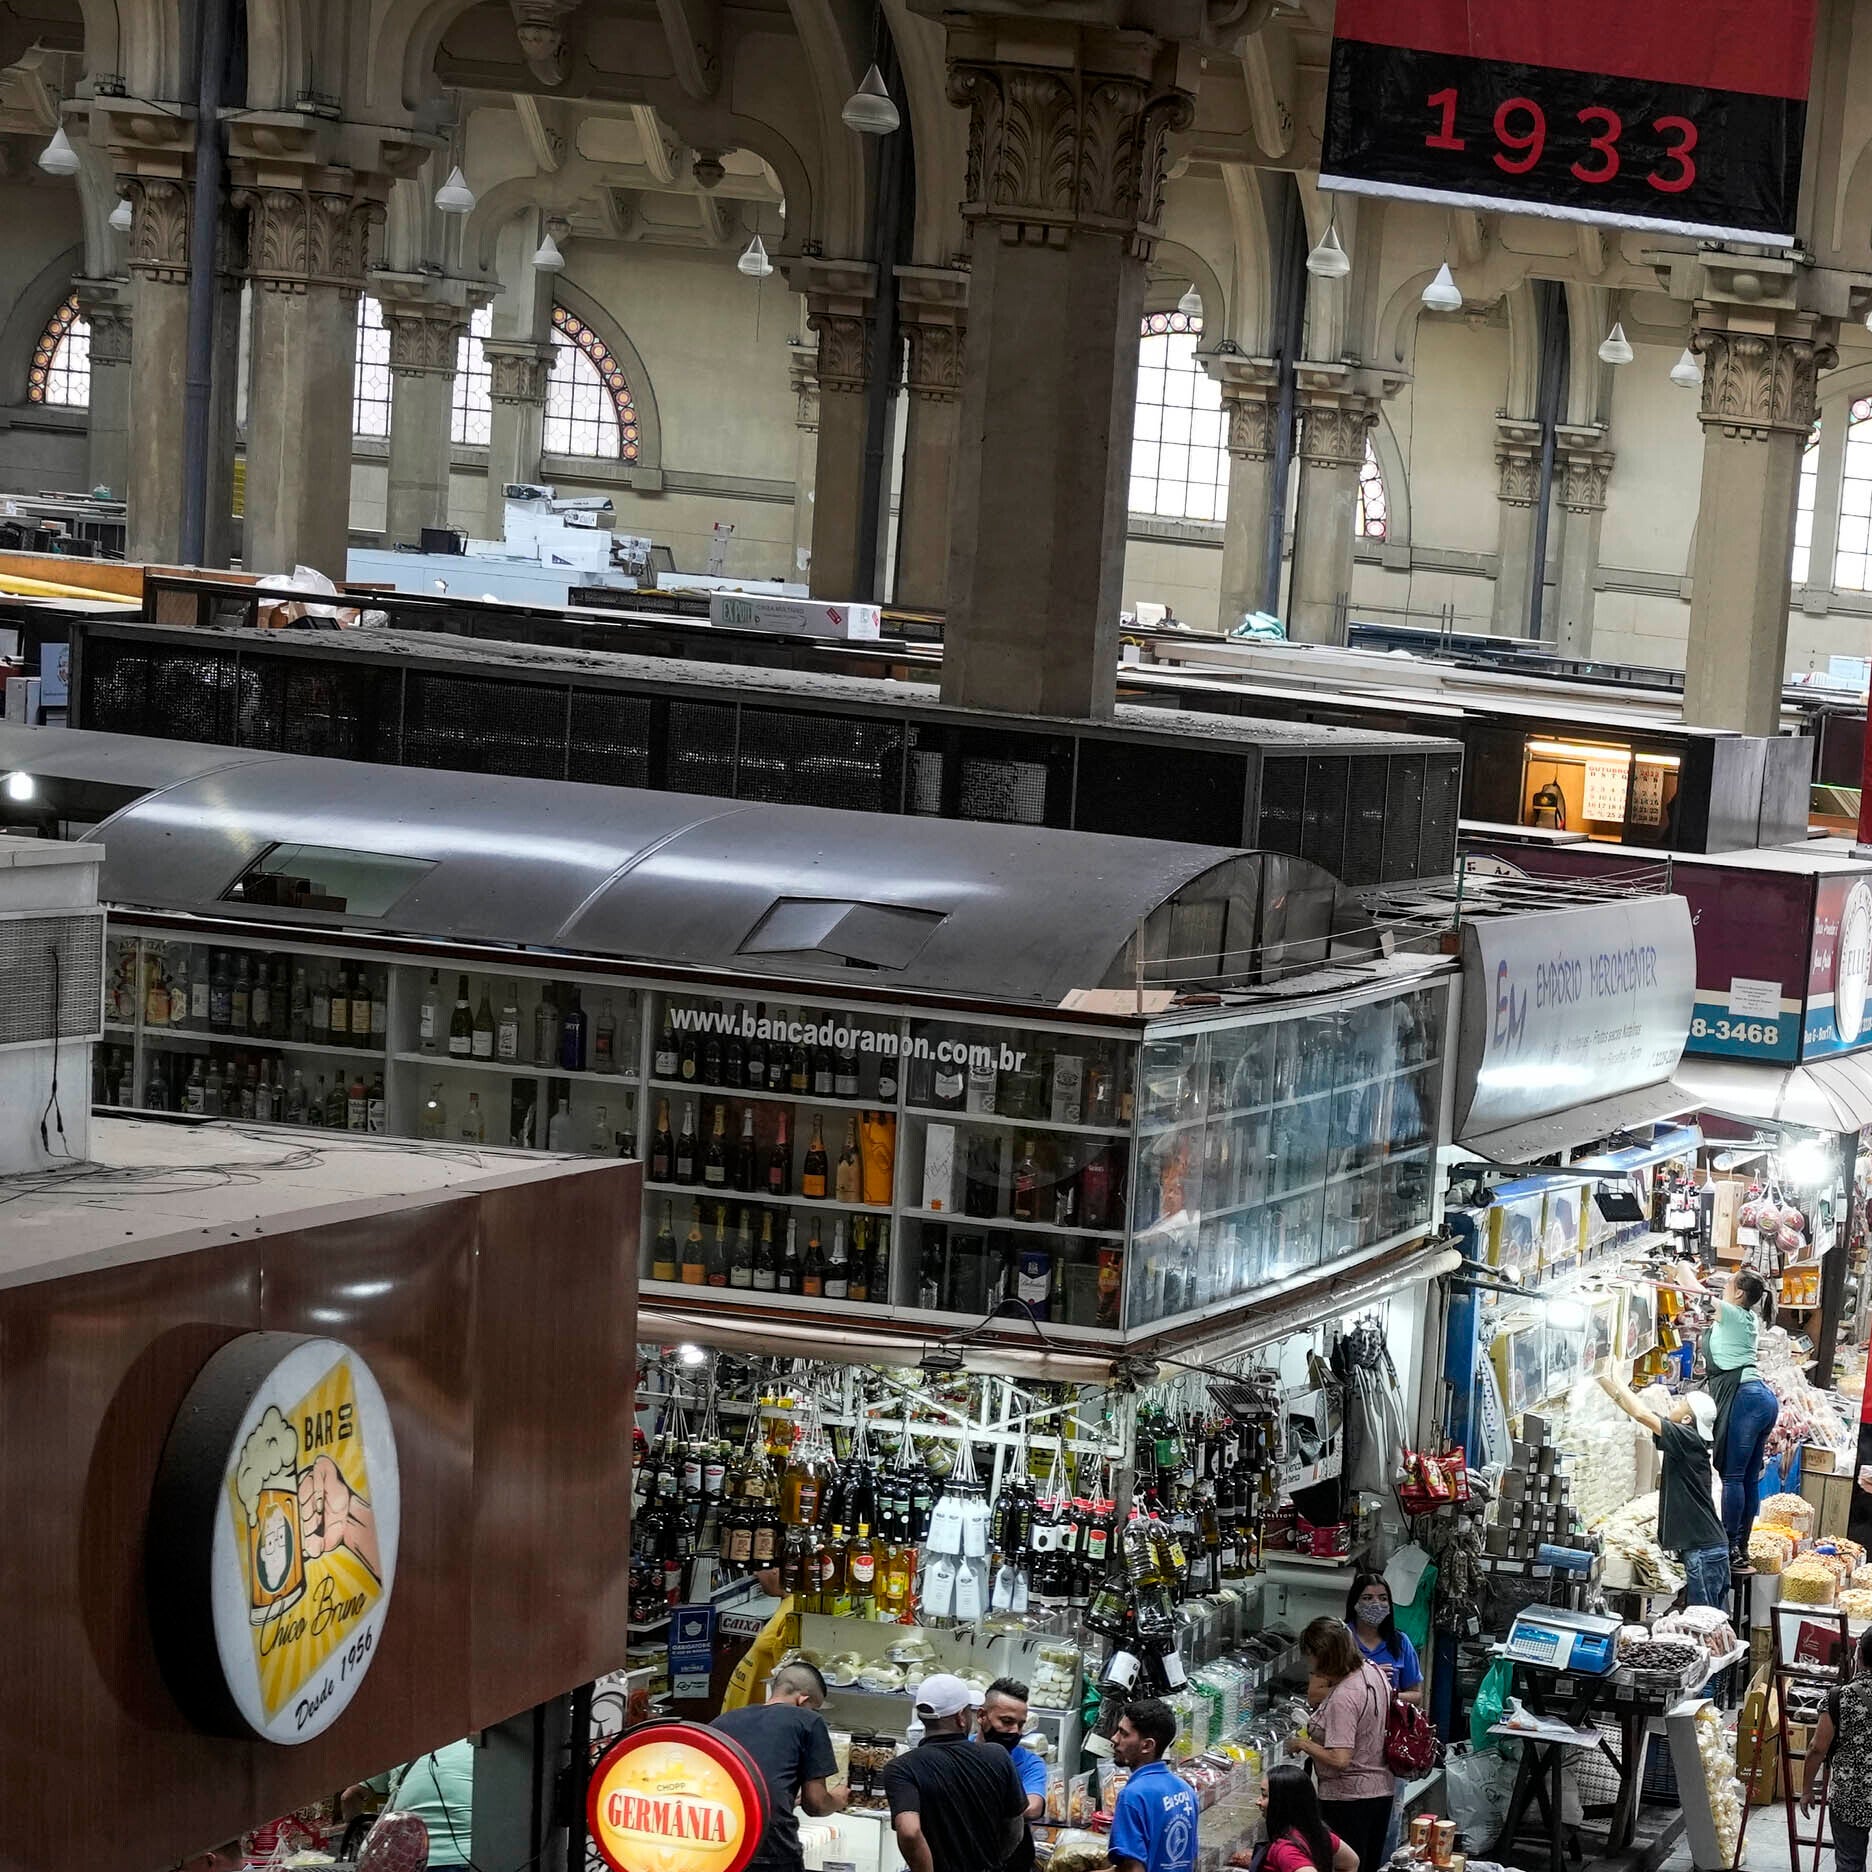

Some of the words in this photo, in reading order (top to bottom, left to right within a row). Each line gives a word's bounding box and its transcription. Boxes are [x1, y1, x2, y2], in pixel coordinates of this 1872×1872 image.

[1425, 87, 1699, 193] 1933
[1536, 952, 1583, 1008] EMPÓRIO
[1590, 945, 1659, 998] MERCACENTER
[670, 1007, 1027, 1073] www.bancadoramon.com.br
[304, 1412, 333, 1452] BAR
[338, 1402, 353, 1441] DO
[259, 1593, 308, 1657] Chico
[311, 1573, 367, 1638] Bruno
[723, 1617, 760, 1633] CAIXA
[295, 1677, 335, 1731] Desde
[340, 1625, 373, 1682] 1956
[608, 1793, 728, 1843] GERMÂNIA
[657, 1782, 686, 1792] CHOPP
